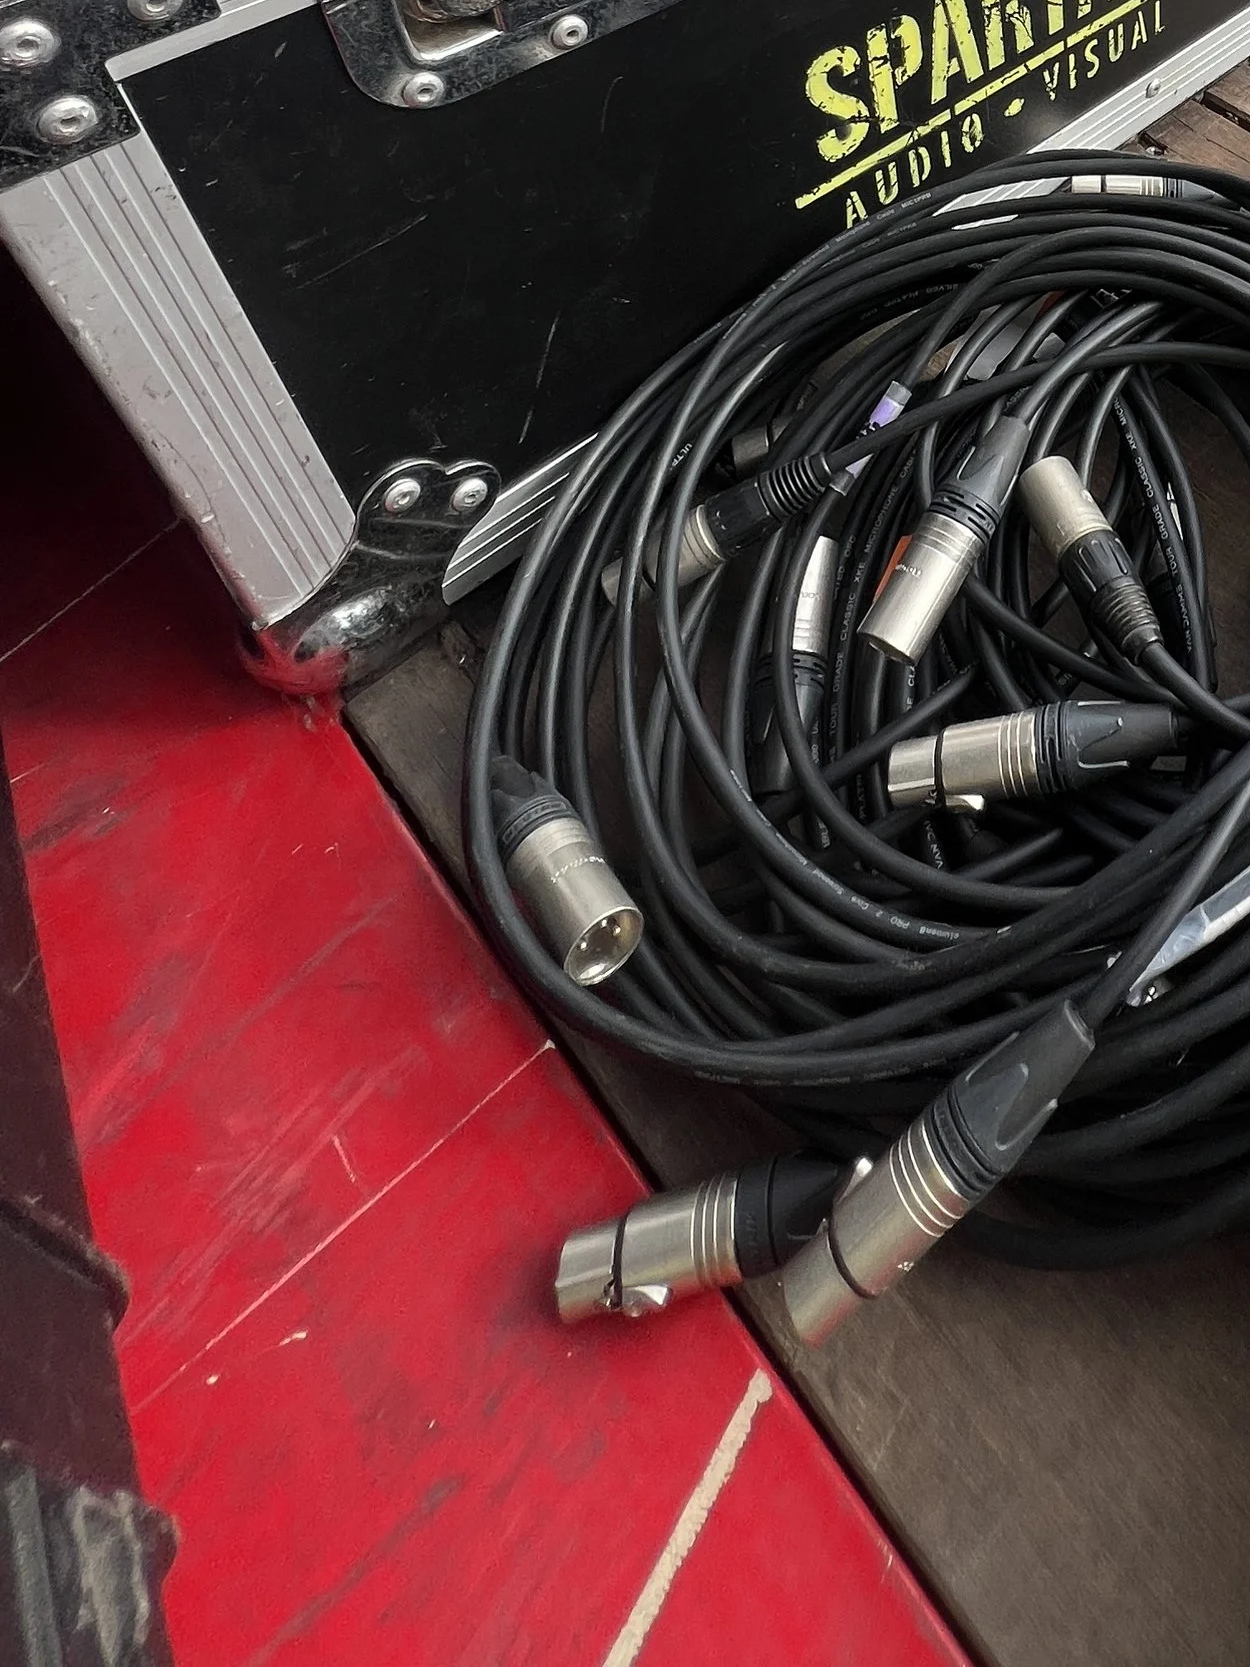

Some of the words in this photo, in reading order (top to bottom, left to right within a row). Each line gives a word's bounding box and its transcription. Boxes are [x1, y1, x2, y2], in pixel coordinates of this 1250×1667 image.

[845, 112, 985, 230] AUDIO
[1043, 0, 1167, 102] VISUAL
[1123, 429, 1138, 451] XKE
[1132, 455, 1157, 498] CLASSIC
[1151, 504, 1170, 540] GRADE
[1164, 545, 1179, 576] TOUR
[890, 914, 910, 929] PRO
